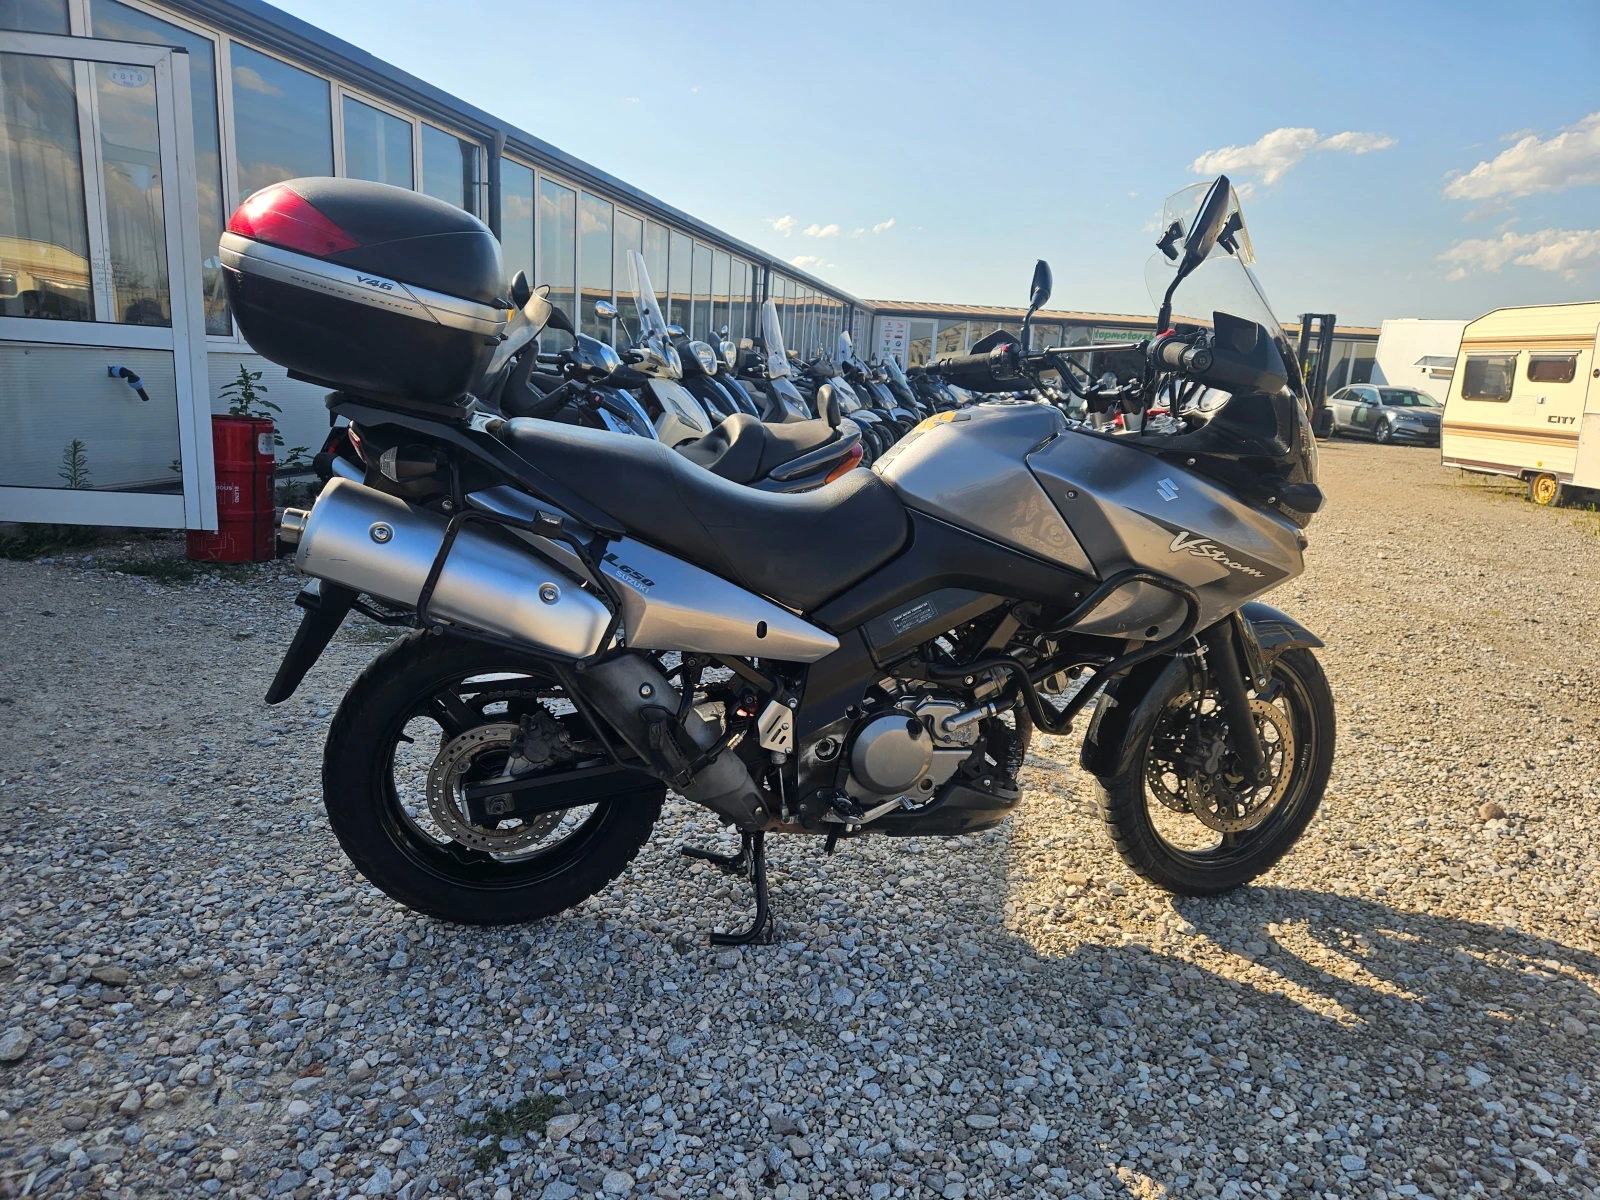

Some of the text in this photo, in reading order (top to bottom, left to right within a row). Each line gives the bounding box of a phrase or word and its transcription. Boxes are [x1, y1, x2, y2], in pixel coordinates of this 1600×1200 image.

[290, 275, 413, 311] MONOKEY SYSTEM
[356, 275, 394, 291] V46
[1547, 415, 1576, 425] CITY
[602, 552, 655, 587] L650
[615, 570, 650, 594] SUZUKI
